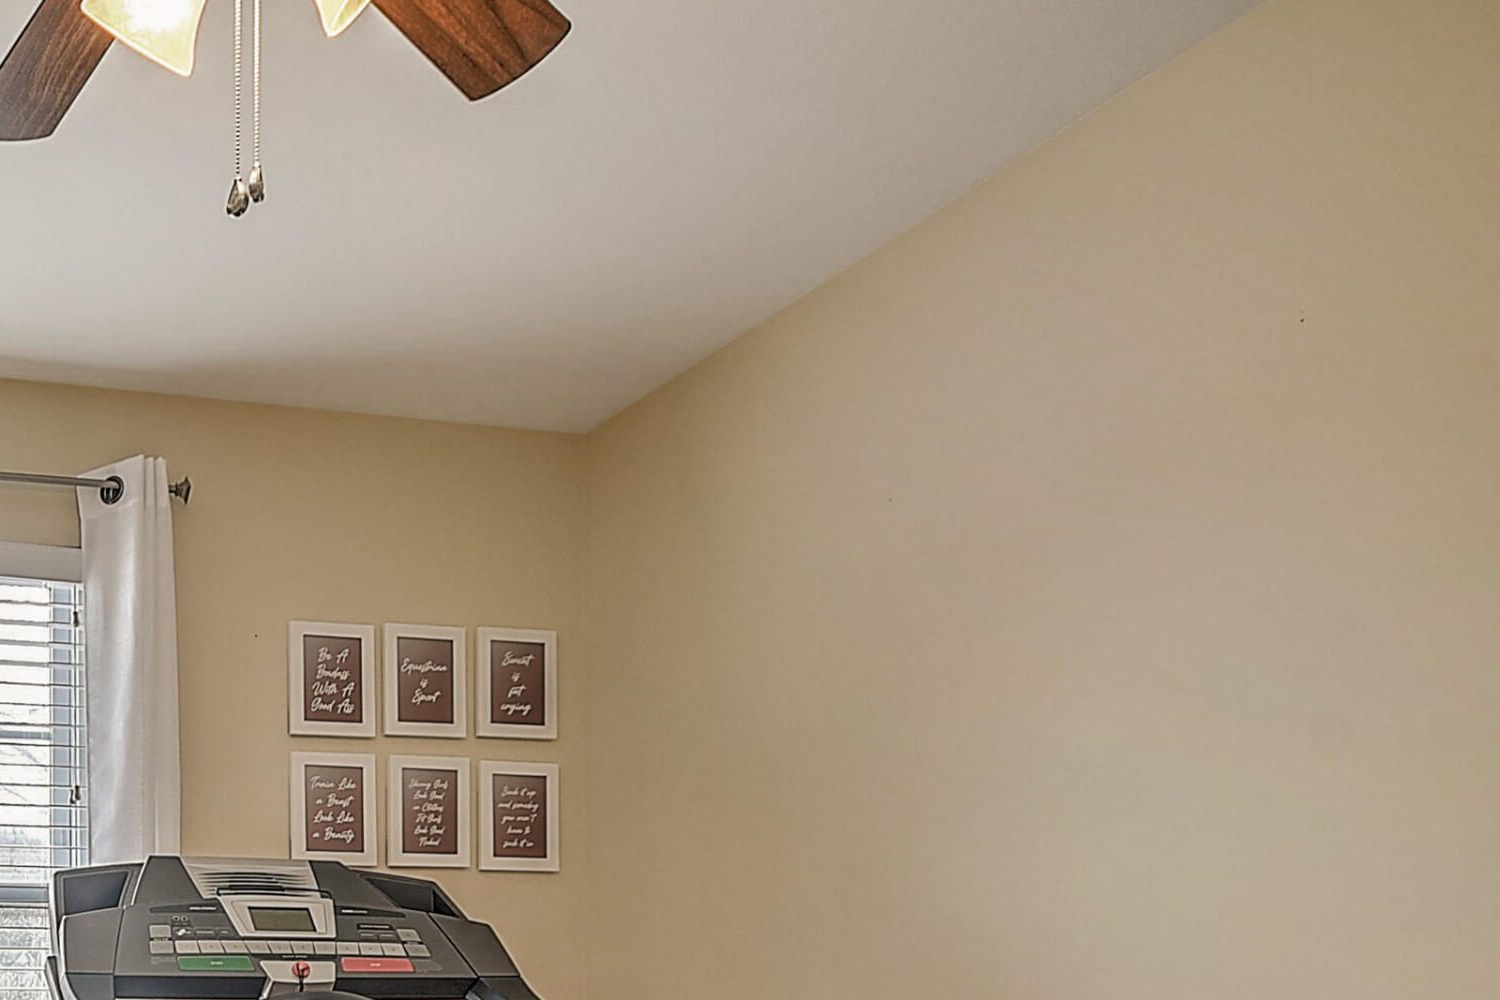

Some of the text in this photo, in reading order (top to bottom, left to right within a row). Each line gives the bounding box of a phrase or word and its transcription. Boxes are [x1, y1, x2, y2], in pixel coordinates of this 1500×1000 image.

[318, 647, 349, 663] Be A
[501, 651, 535, 666] Sweat
[312, 681, 355, 697] With A
[508, 684, 527, 698] Fat
[311, 697, 355, 714] Good Ass
[309, 775, 356, 791] Train Like
[327, 793, 354, 808] Beast
[313, 810, 354, 824] Look Like
[324, 826, 355, 844] Beauty
